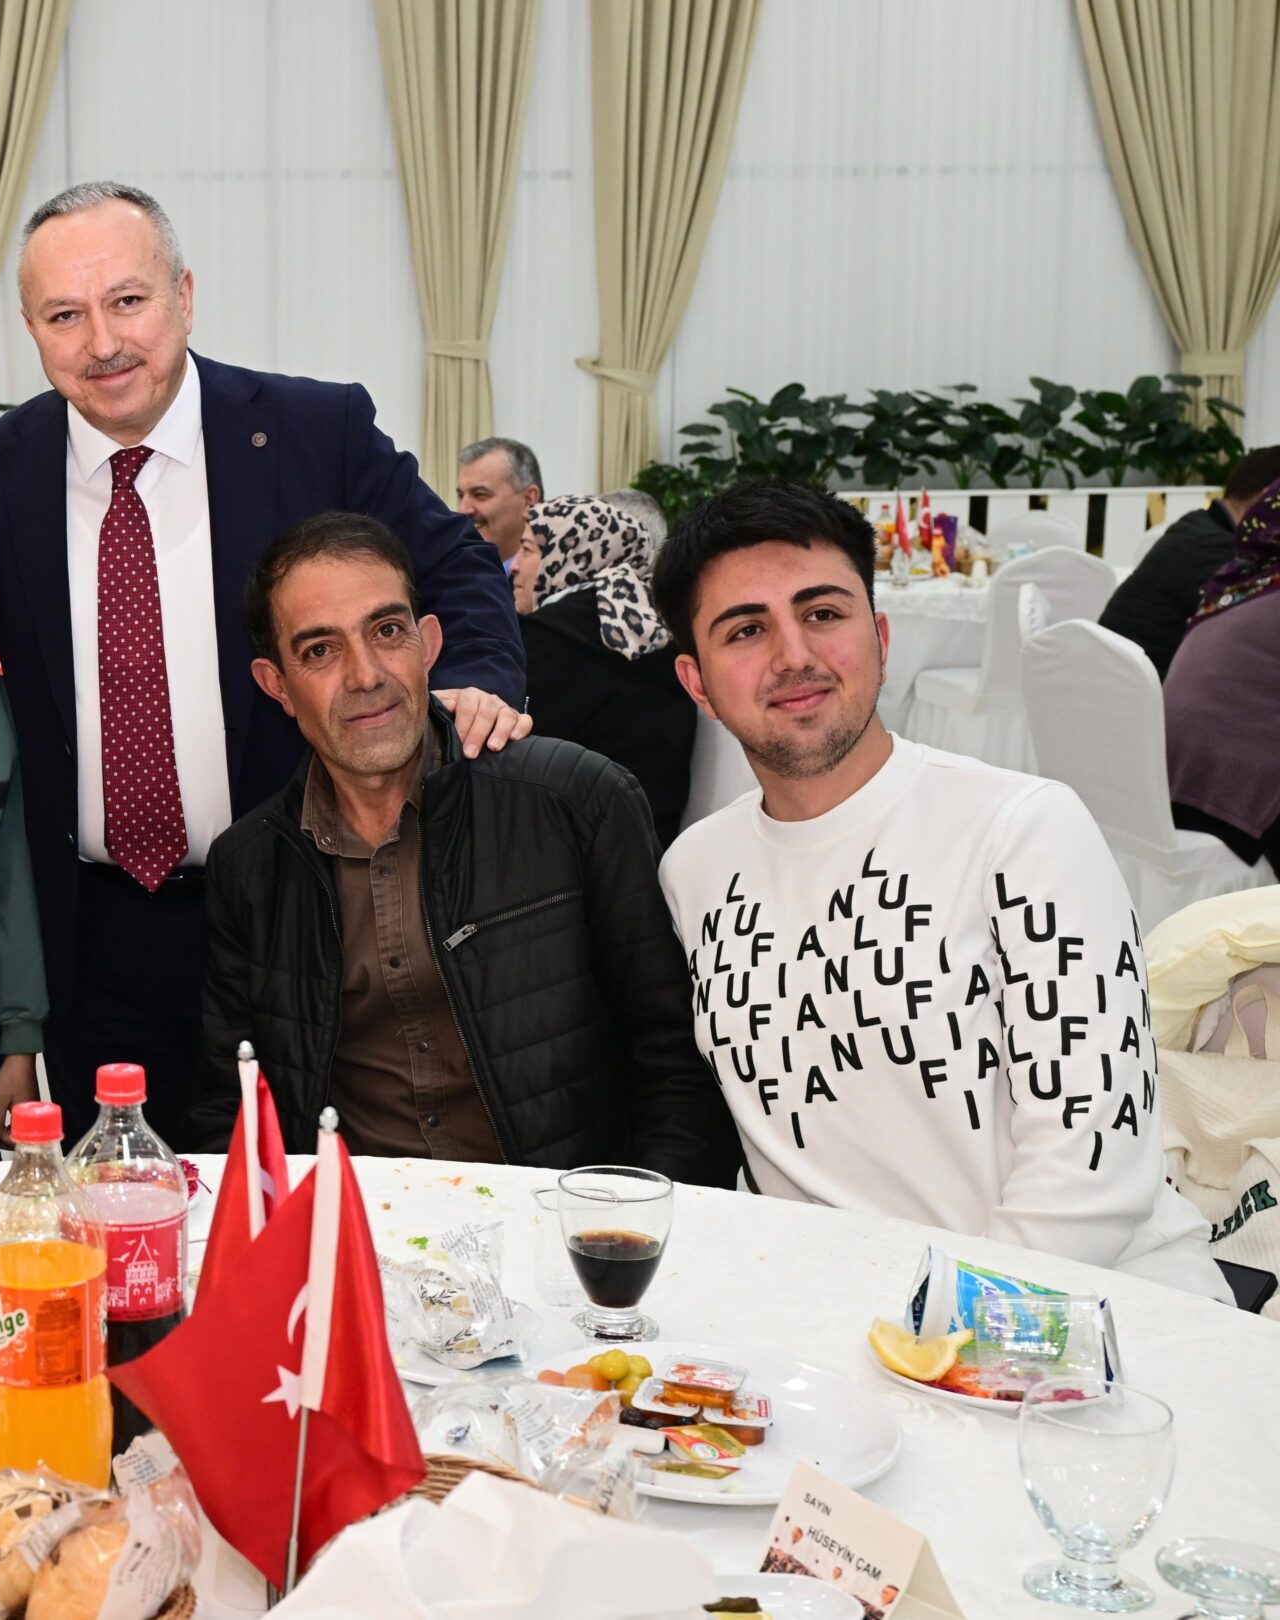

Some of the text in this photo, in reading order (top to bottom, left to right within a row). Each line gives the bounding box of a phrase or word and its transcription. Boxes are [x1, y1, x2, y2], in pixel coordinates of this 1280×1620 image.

[803, 1492, 832, 1516] SAYIN
[806, 1525, 882, 1581] HÜSEYİN ÇAM
